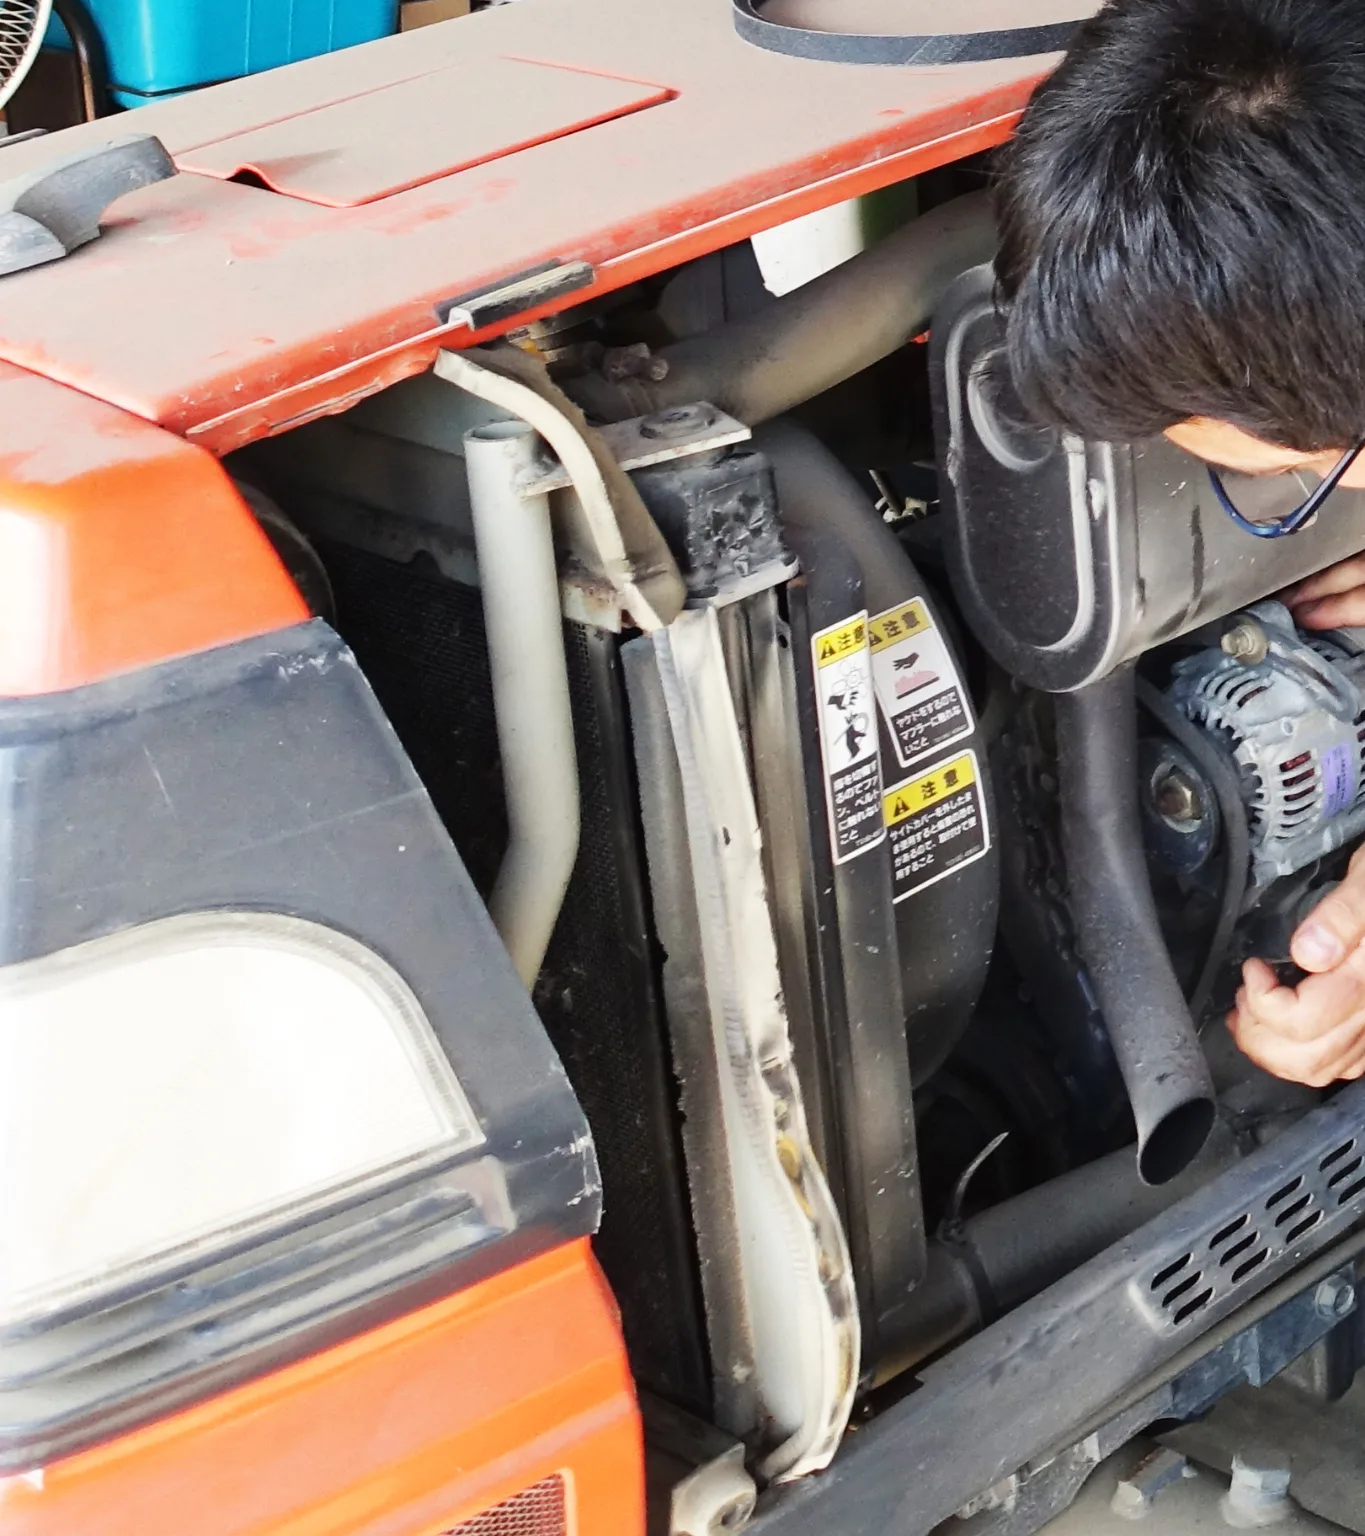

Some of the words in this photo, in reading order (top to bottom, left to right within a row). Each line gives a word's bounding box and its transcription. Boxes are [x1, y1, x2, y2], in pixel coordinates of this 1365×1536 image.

[837, 623, 867, 652] 注意
[882, 610, 921, 638] 注意
[920, 767, 960, 801] 注意
